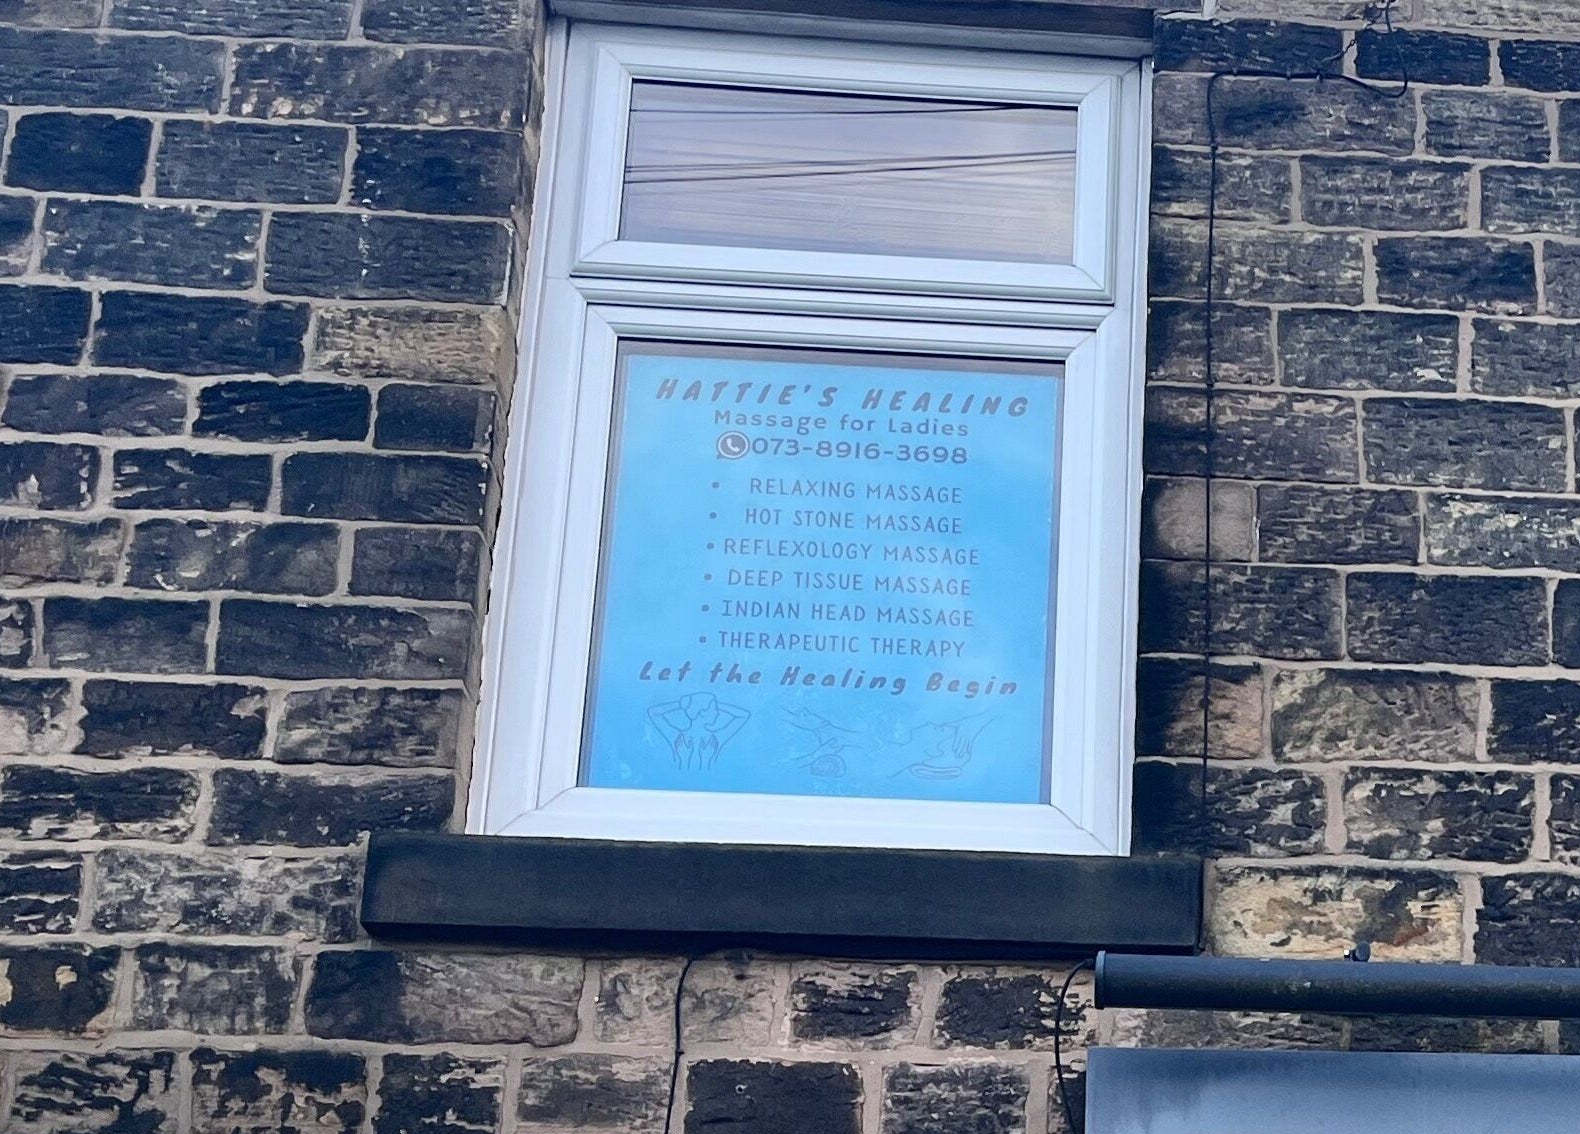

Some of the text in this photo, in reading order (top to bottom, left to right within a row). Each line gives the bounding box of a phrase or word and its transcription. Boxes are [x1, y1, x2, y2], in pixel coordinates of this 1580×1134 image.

[656, 378, 1028, 417] HATTIE'S HEALING
[714, 410, 969, 437] Massage for Ladies
[751, 437, 968, 465] 073-8916-3698
[750, 477, 962, 504] RELAXING MASSAGE
[745, 507, 962, 534] HOT STONE MASSAGE
[724, 538, 980, 566] REFLEXOLOGY MASSAGE
[728, 568, 971, 596] DEEP TISSUE MASSAGE
[722, 600, 974, 627] INDIAN HEAD MASSAGE
[718, 630, 966, 658] THERAPEUTIC THERAPY
[639, 660, 1018, 699] Let the Healing Begin
